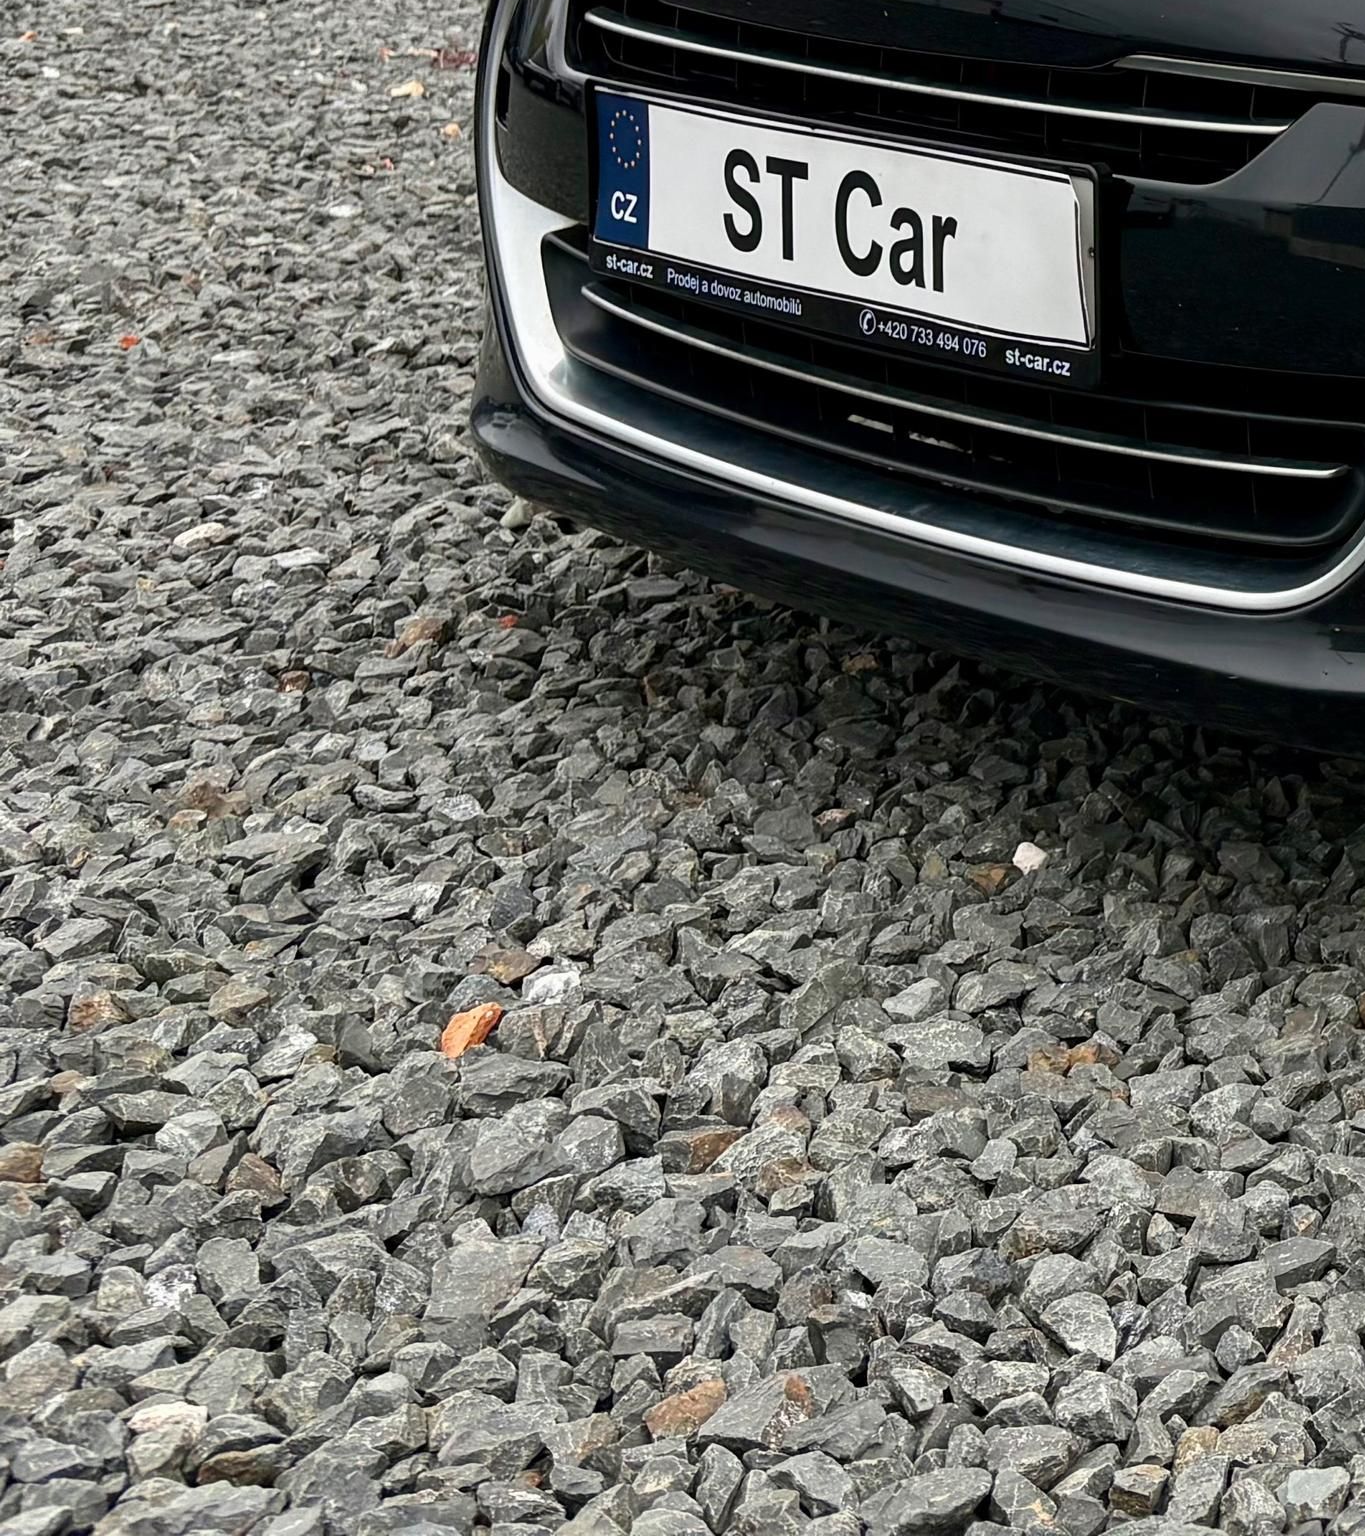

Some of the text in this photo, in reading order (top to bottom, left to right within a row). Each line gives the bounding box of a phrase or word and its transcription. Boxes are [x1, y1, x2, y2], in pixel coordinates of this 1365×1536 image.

[611, 190, 638, 224] CZ
[723, 148, 958, 294] ST Car
[606, 254, 654, 279] st-car.cz
[666, 267, 802, 316] Prodej a dovoz automobilů
[877, 320, 987, 358] +420 733 494 076
[1005, 347, 1071, 377] st-car.cz
